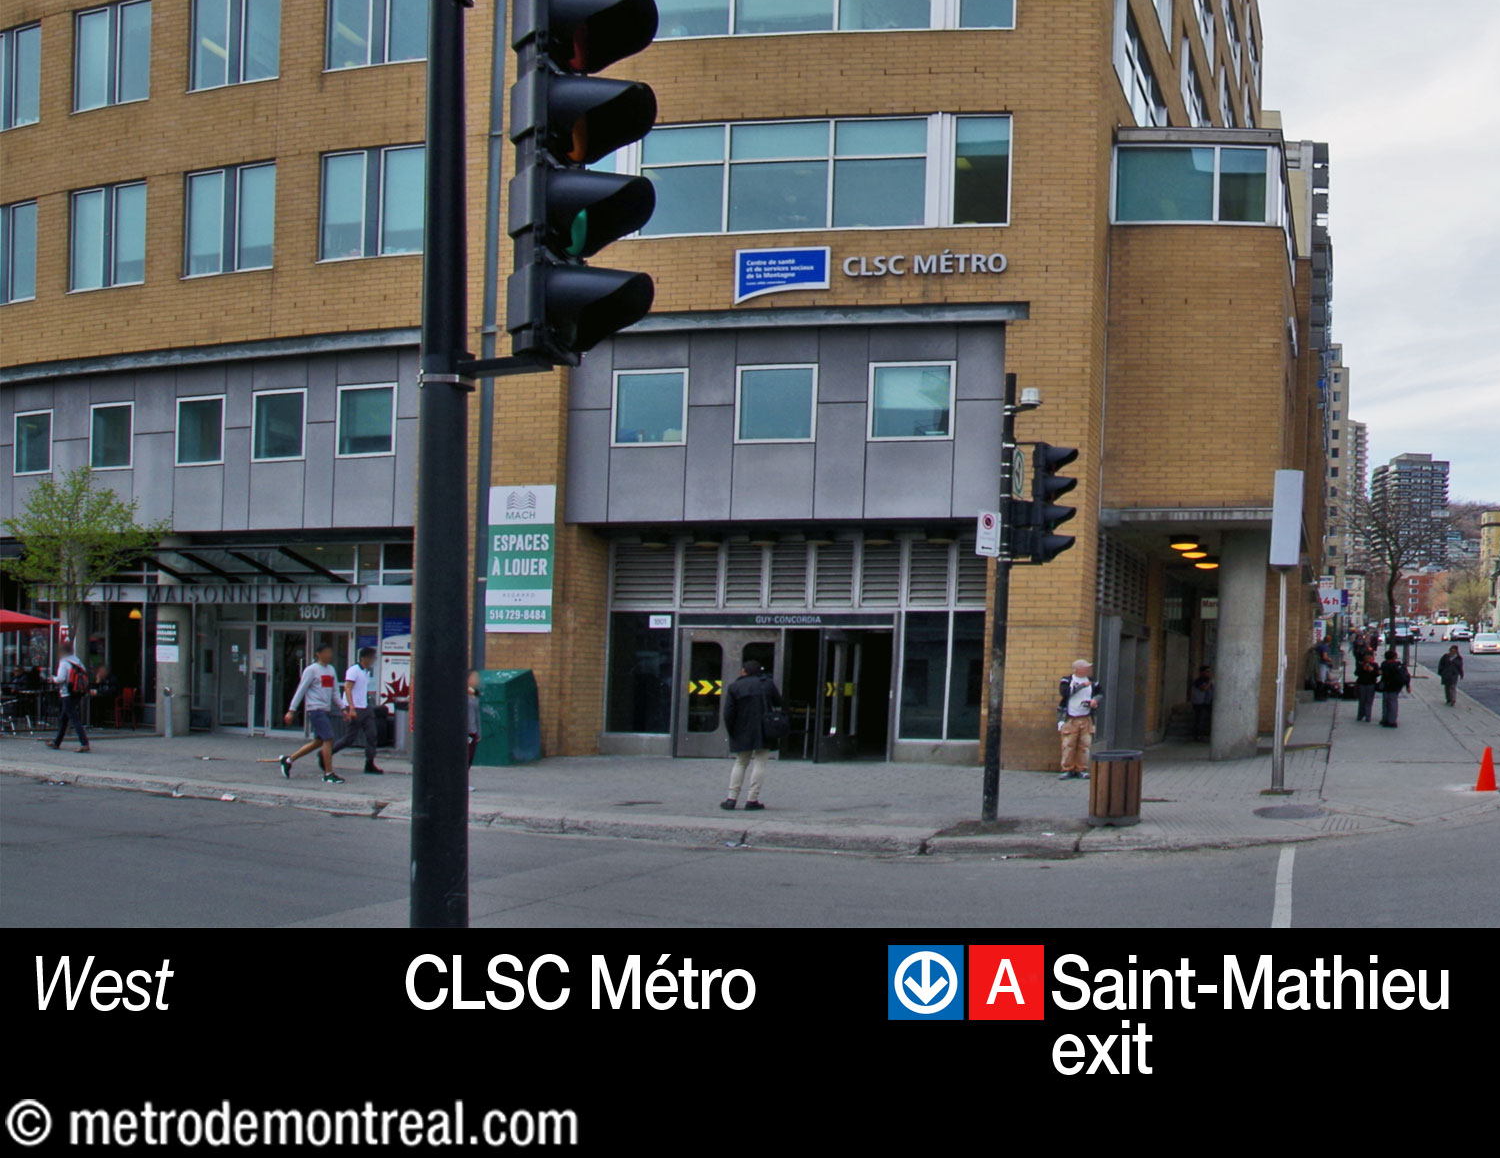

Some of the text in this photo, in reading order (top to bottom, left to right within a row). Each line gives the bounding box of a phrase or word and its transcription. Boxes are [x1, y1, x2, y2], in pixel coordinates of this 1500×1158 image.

[842, 249, 1008, 276] CLSC MÉTRO
[506, 511, 536, 520] MACH
[493, 534, 549, 552] ESPACES
[491, 556, 548, 576] À LOUER
[149, 584, 317, 604] MAISONNEUVE
[299, 605, 326, 619] 1801
[489, 609, 547, 620] 514 729-8484
[755, 615, 821, 624] GUY-CONCORDIA
